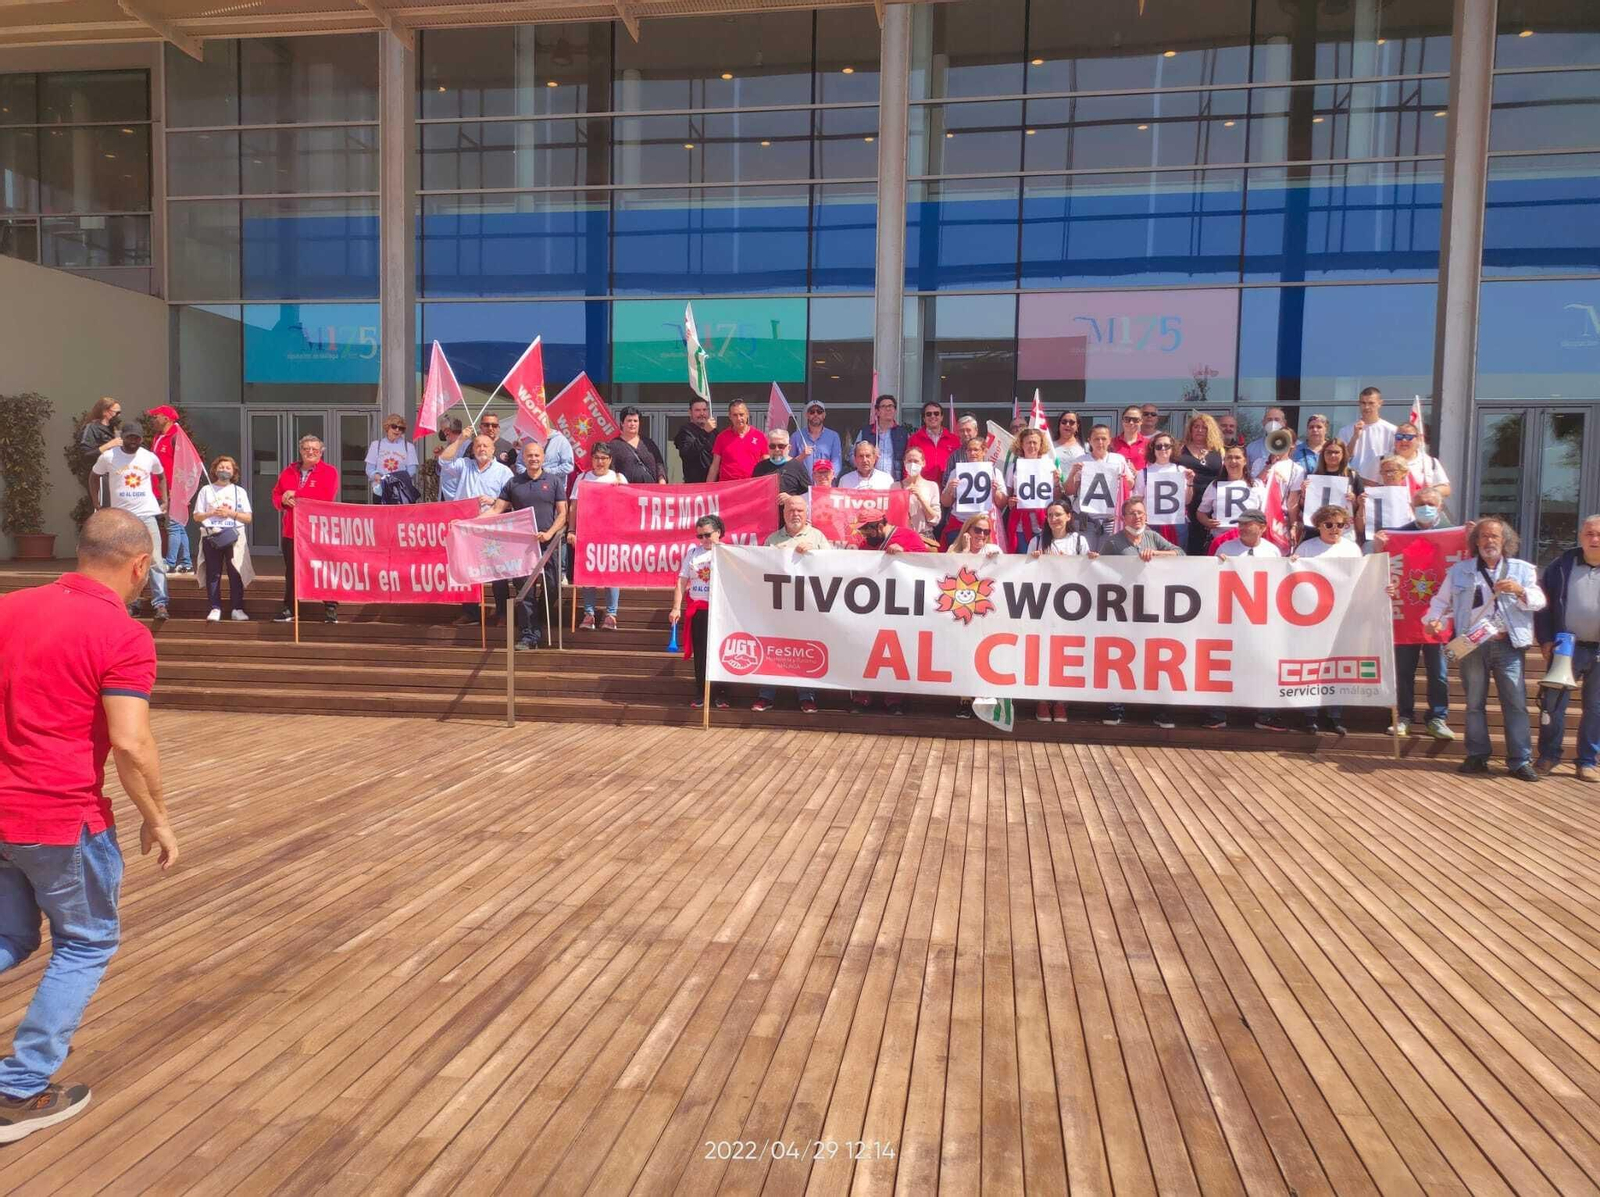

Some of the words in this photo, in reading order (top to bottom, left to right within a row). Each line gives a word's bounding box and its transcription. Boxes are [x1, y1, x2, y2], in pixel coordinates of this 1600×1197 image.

[583, 391, 615, 436] Tivoli
[830, 495, 889, 510] Tivoli
[958, 471, 991, 504] 29
[1018, 475, 1052, 500] de
[1081, 473, 1115, 508] A
[1154, 481, 1179, 514] B
[1224, 487, 1249, 517] R
[638, 494, 720, 531] TREMON
[308, 515, 376, 547] TREMON
[310, 560, 370, 591] TIVOLI
[378, 569, 400, 592] en
[764, 573, 926, 616] TIVOLI
[1003, 581, 1202, 624] WORLD
[1217, 570, 1335, 626] NO
[724, 639, 757, 657] UGT
[766, 645, 815, 659] FeSMC
[862, 629, 953, 684] AL
[974, 632, 1234, 693] CIERRE
[1279, 684, 1336, 698] servicios
[1340, 685, 1380, 697] málaga
